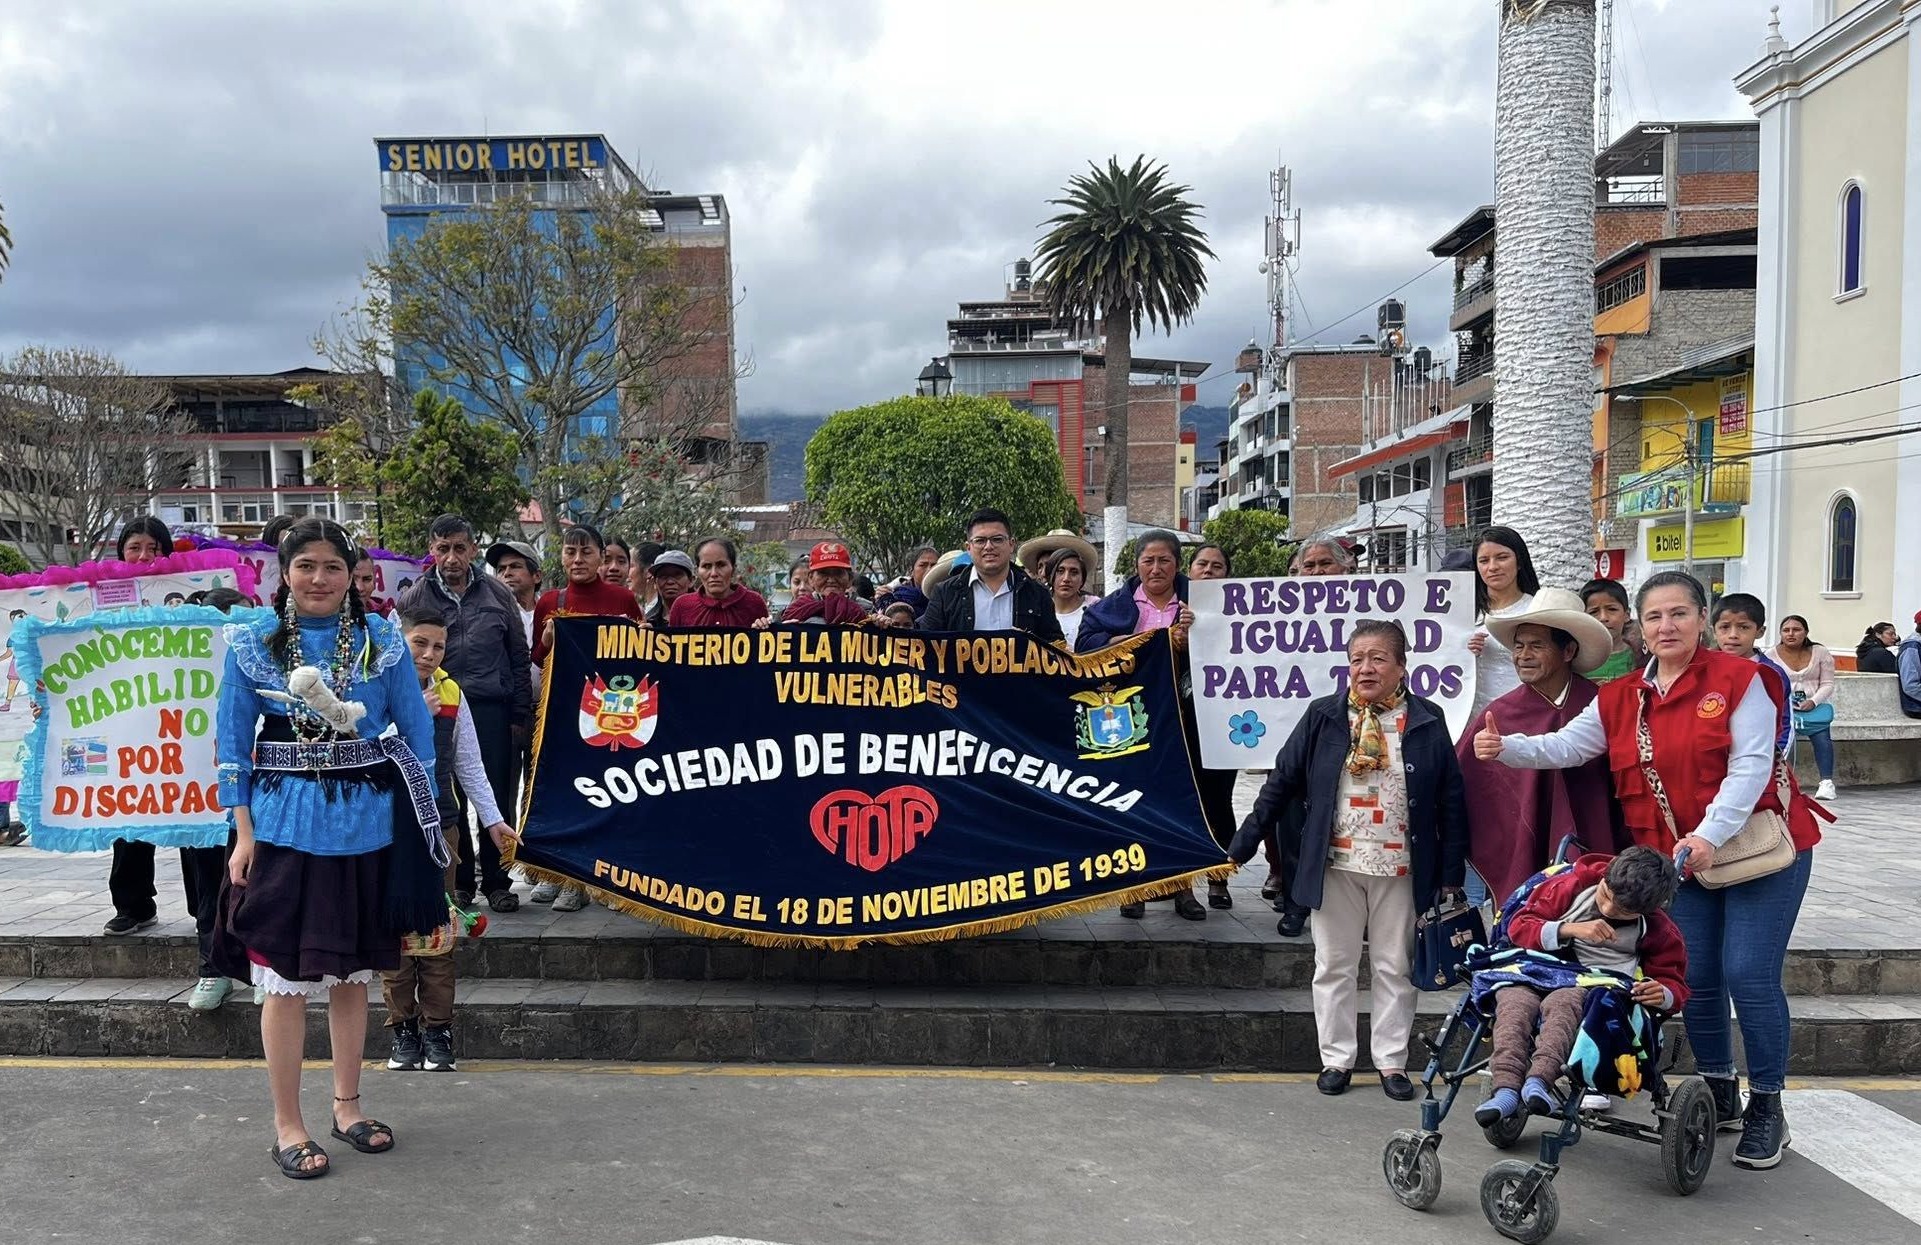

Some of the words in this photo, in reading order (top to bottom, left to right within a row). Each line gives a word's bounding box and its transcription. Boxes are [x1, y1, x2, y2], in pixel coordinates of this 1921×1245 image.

[388, 143, 491, 171] SENIOR
[507, 141, 597, 169] HOTEL
[1662, 534, 1682, 551] bitel
[1222, 579, 1405, 616] RESPETO
[1423, 579, 1452, 614] E
[596, 624, 750, 666] MINISTERIO
[758, 631, 793, 663] DE
[800, 631, 833, 663] LA
[841, 630, 926, 670] MUJER
[931, 639, 948, 673] Y
[955, 637, 1136, 678] POBLACIONES
[1229, 618, 1443, 654] IGUALD
[66, 668, 219, 729] HABILID
[774, 671, 959, 709] VULNERABLES
[1203, 665, 1312, 699] PARA
[1329, 665, 1464, 699] TOS
[158, 708, 209, 740] NO
[117, 742, 184, 778] POR
[573, 738, 783, 808] SOCIEDAD
[794, 732, 845, 777] DE
[859, 729, 1143, 813] BENEFICENCIA
[594, 859, 726, 916] FUNDADO
[733, 894, 767, 922] EL
[777, 897, 809, 925] 18
[816, 896, 853, 925] DE
[862, 870, 1026, 923] NOVIEMBRE
[1033, 861, 1071, 896] DE
[1079, 842, 1147, 881] 1939
